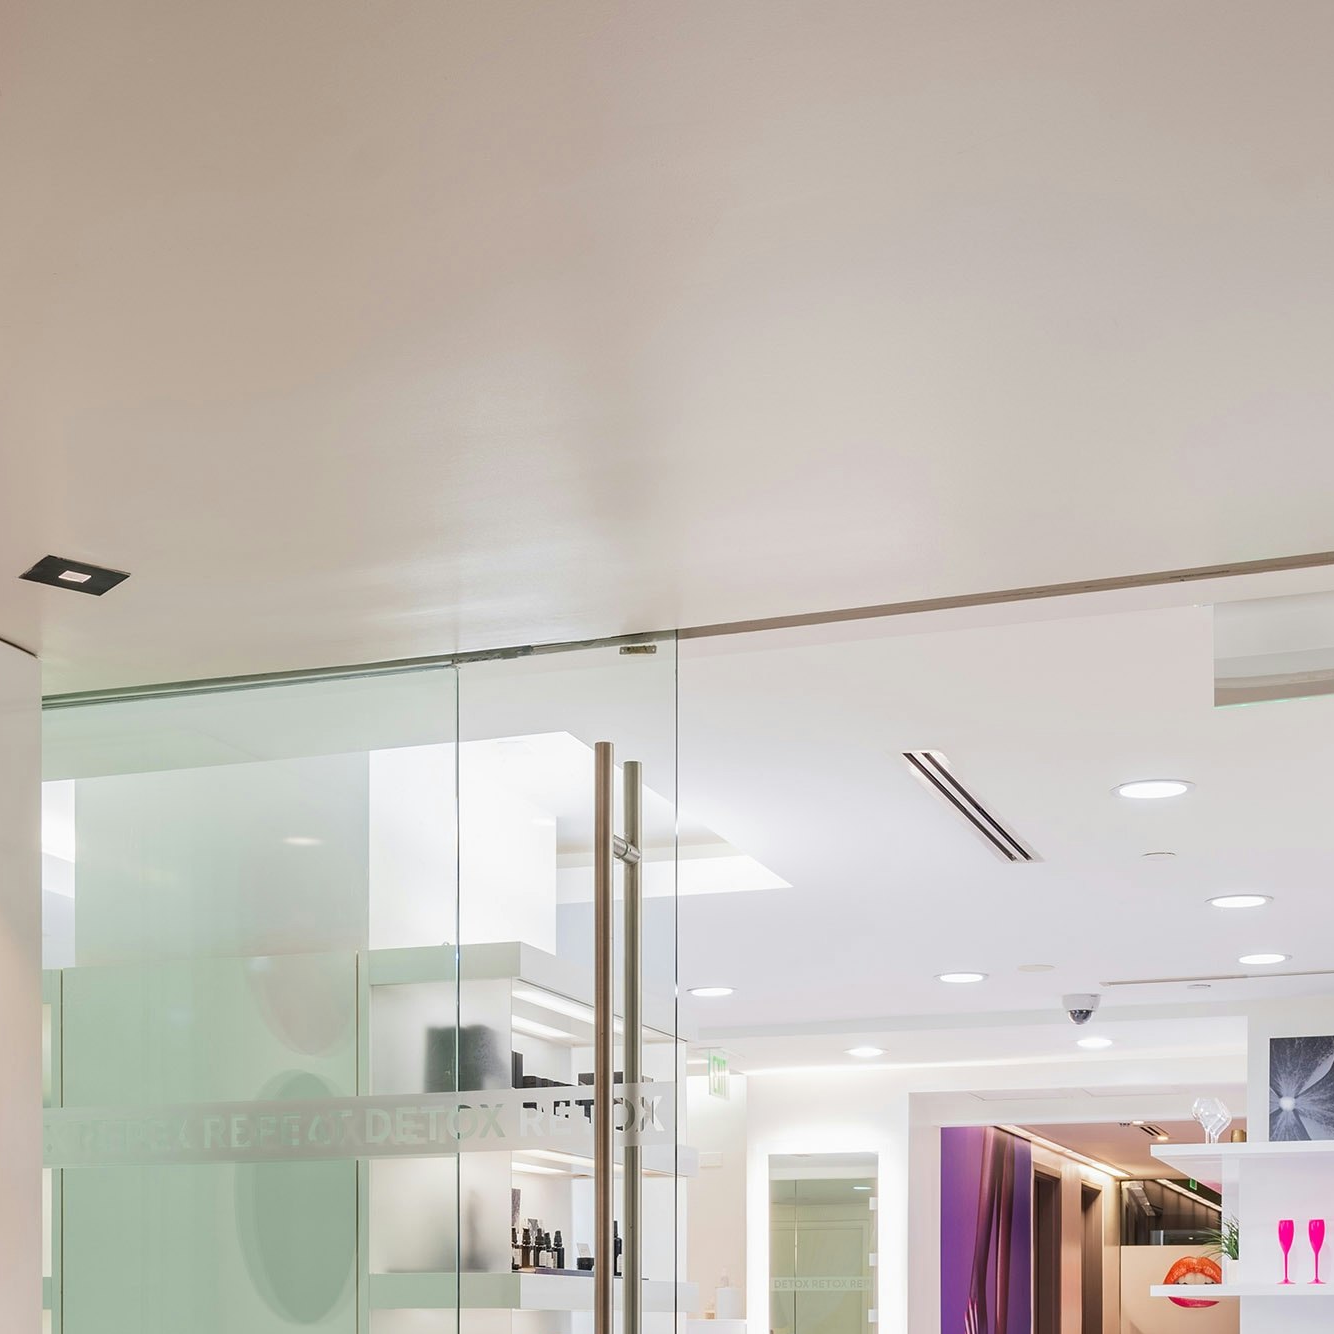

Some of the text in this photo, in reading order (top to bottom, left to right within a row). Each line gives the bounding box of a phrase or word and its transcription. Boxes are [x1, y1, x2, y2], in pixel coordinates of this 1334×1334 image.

[364, 1103, 507, 1144] DETOX
[774, 1279, 810, 1290] DETOX
[810, 1279, 848, 1289] RETOX
